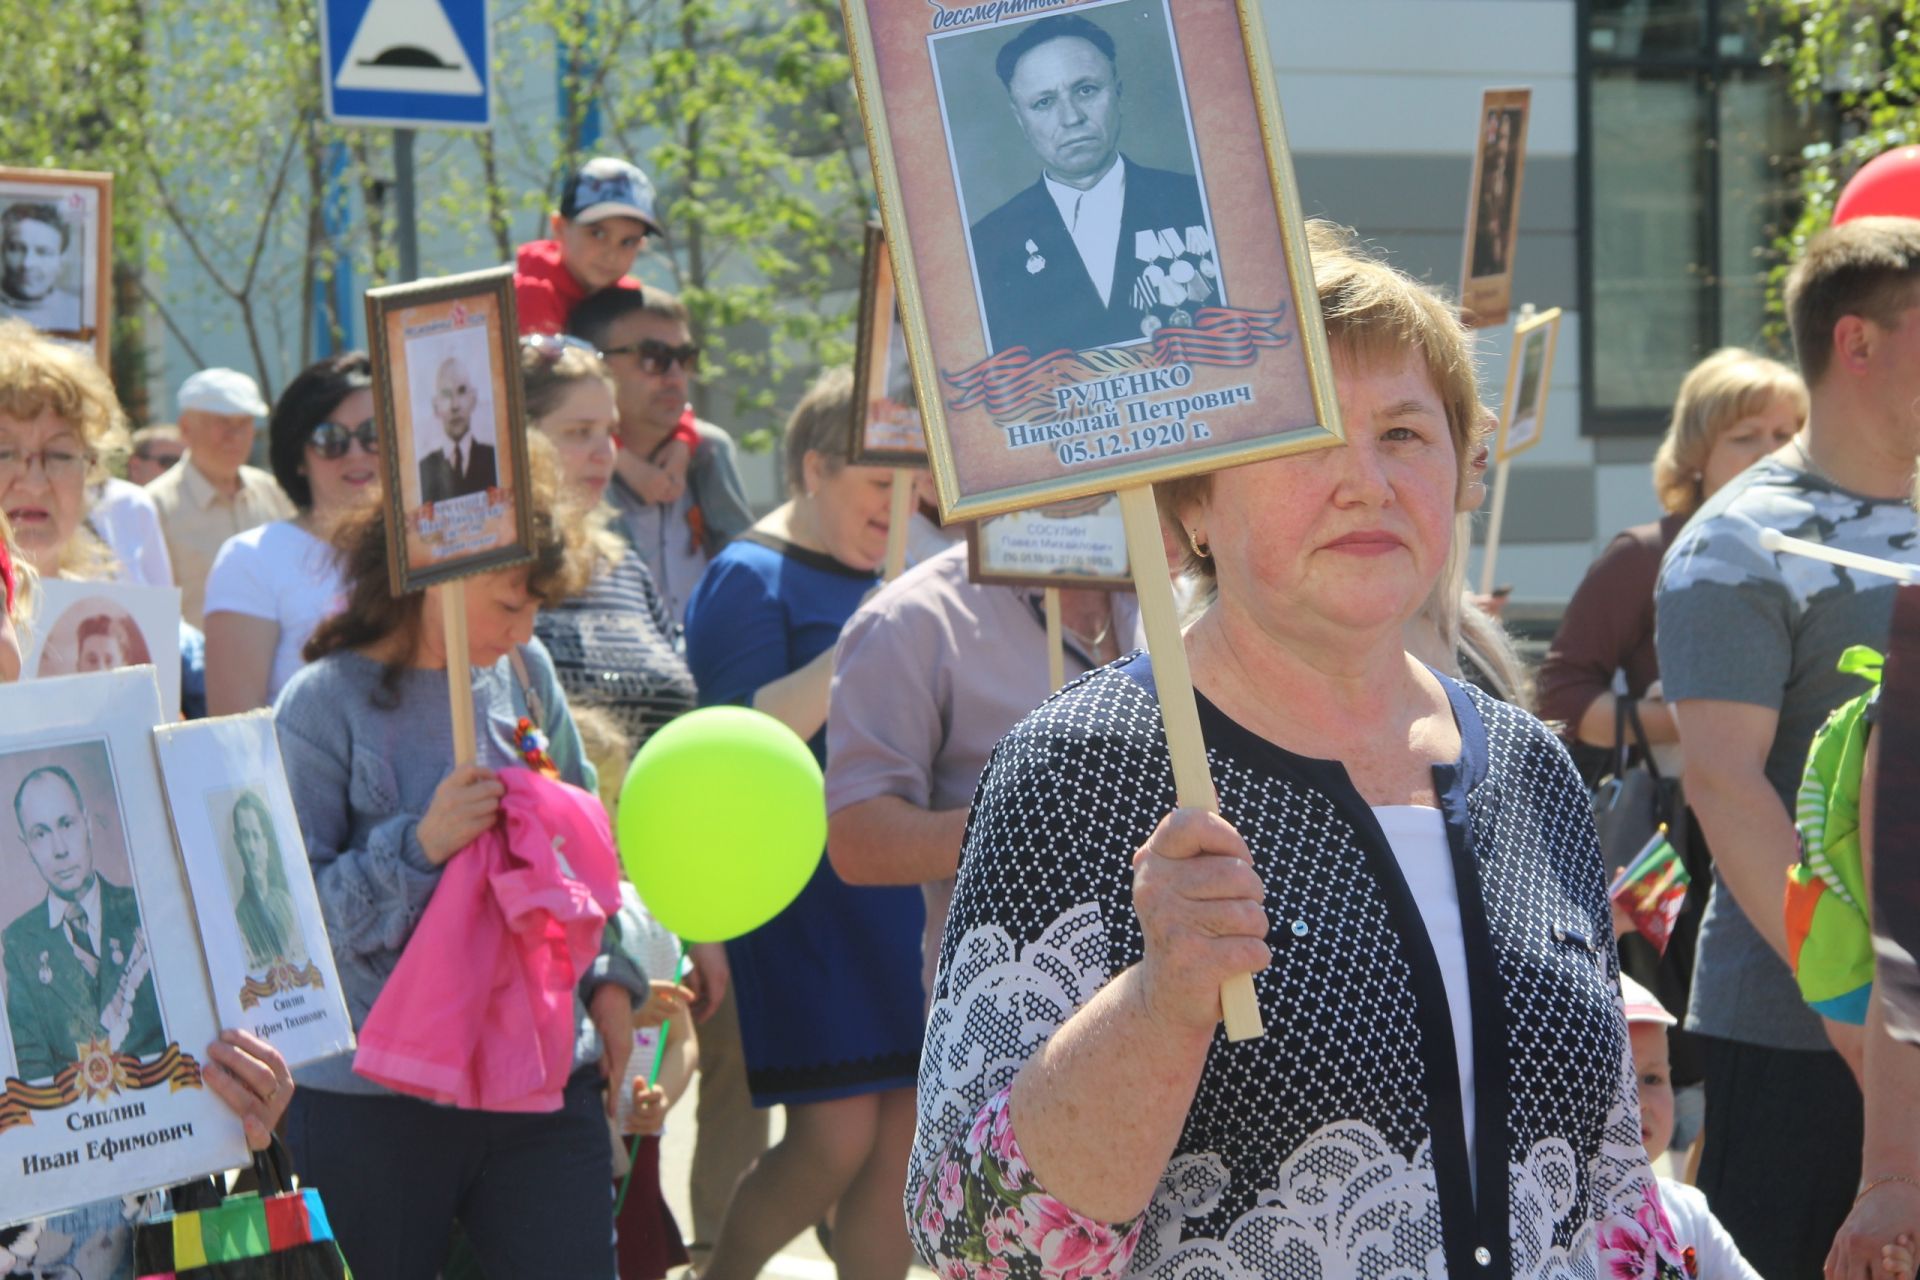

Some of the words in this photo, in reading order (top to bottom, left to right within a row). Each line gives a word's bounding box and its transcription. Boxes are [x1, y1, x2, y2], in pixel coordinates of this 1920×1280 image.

[1056, 365, 1191, 410] РУДЕНКО
[1007, 408, 1120, 447] Николай
[1127, 385, 1252, 423] Петрович
[1059, 421, 1185, 465] 05.12.1920
[1193, 422, 1210, 440] г.
[255, 1022, 283, 1039] Ефим
[66, 1101, 146, 1132] Сяплин
[22, 1149, 79, 1176] Иван
[86, 1121, 194, 1162] Ефимович
